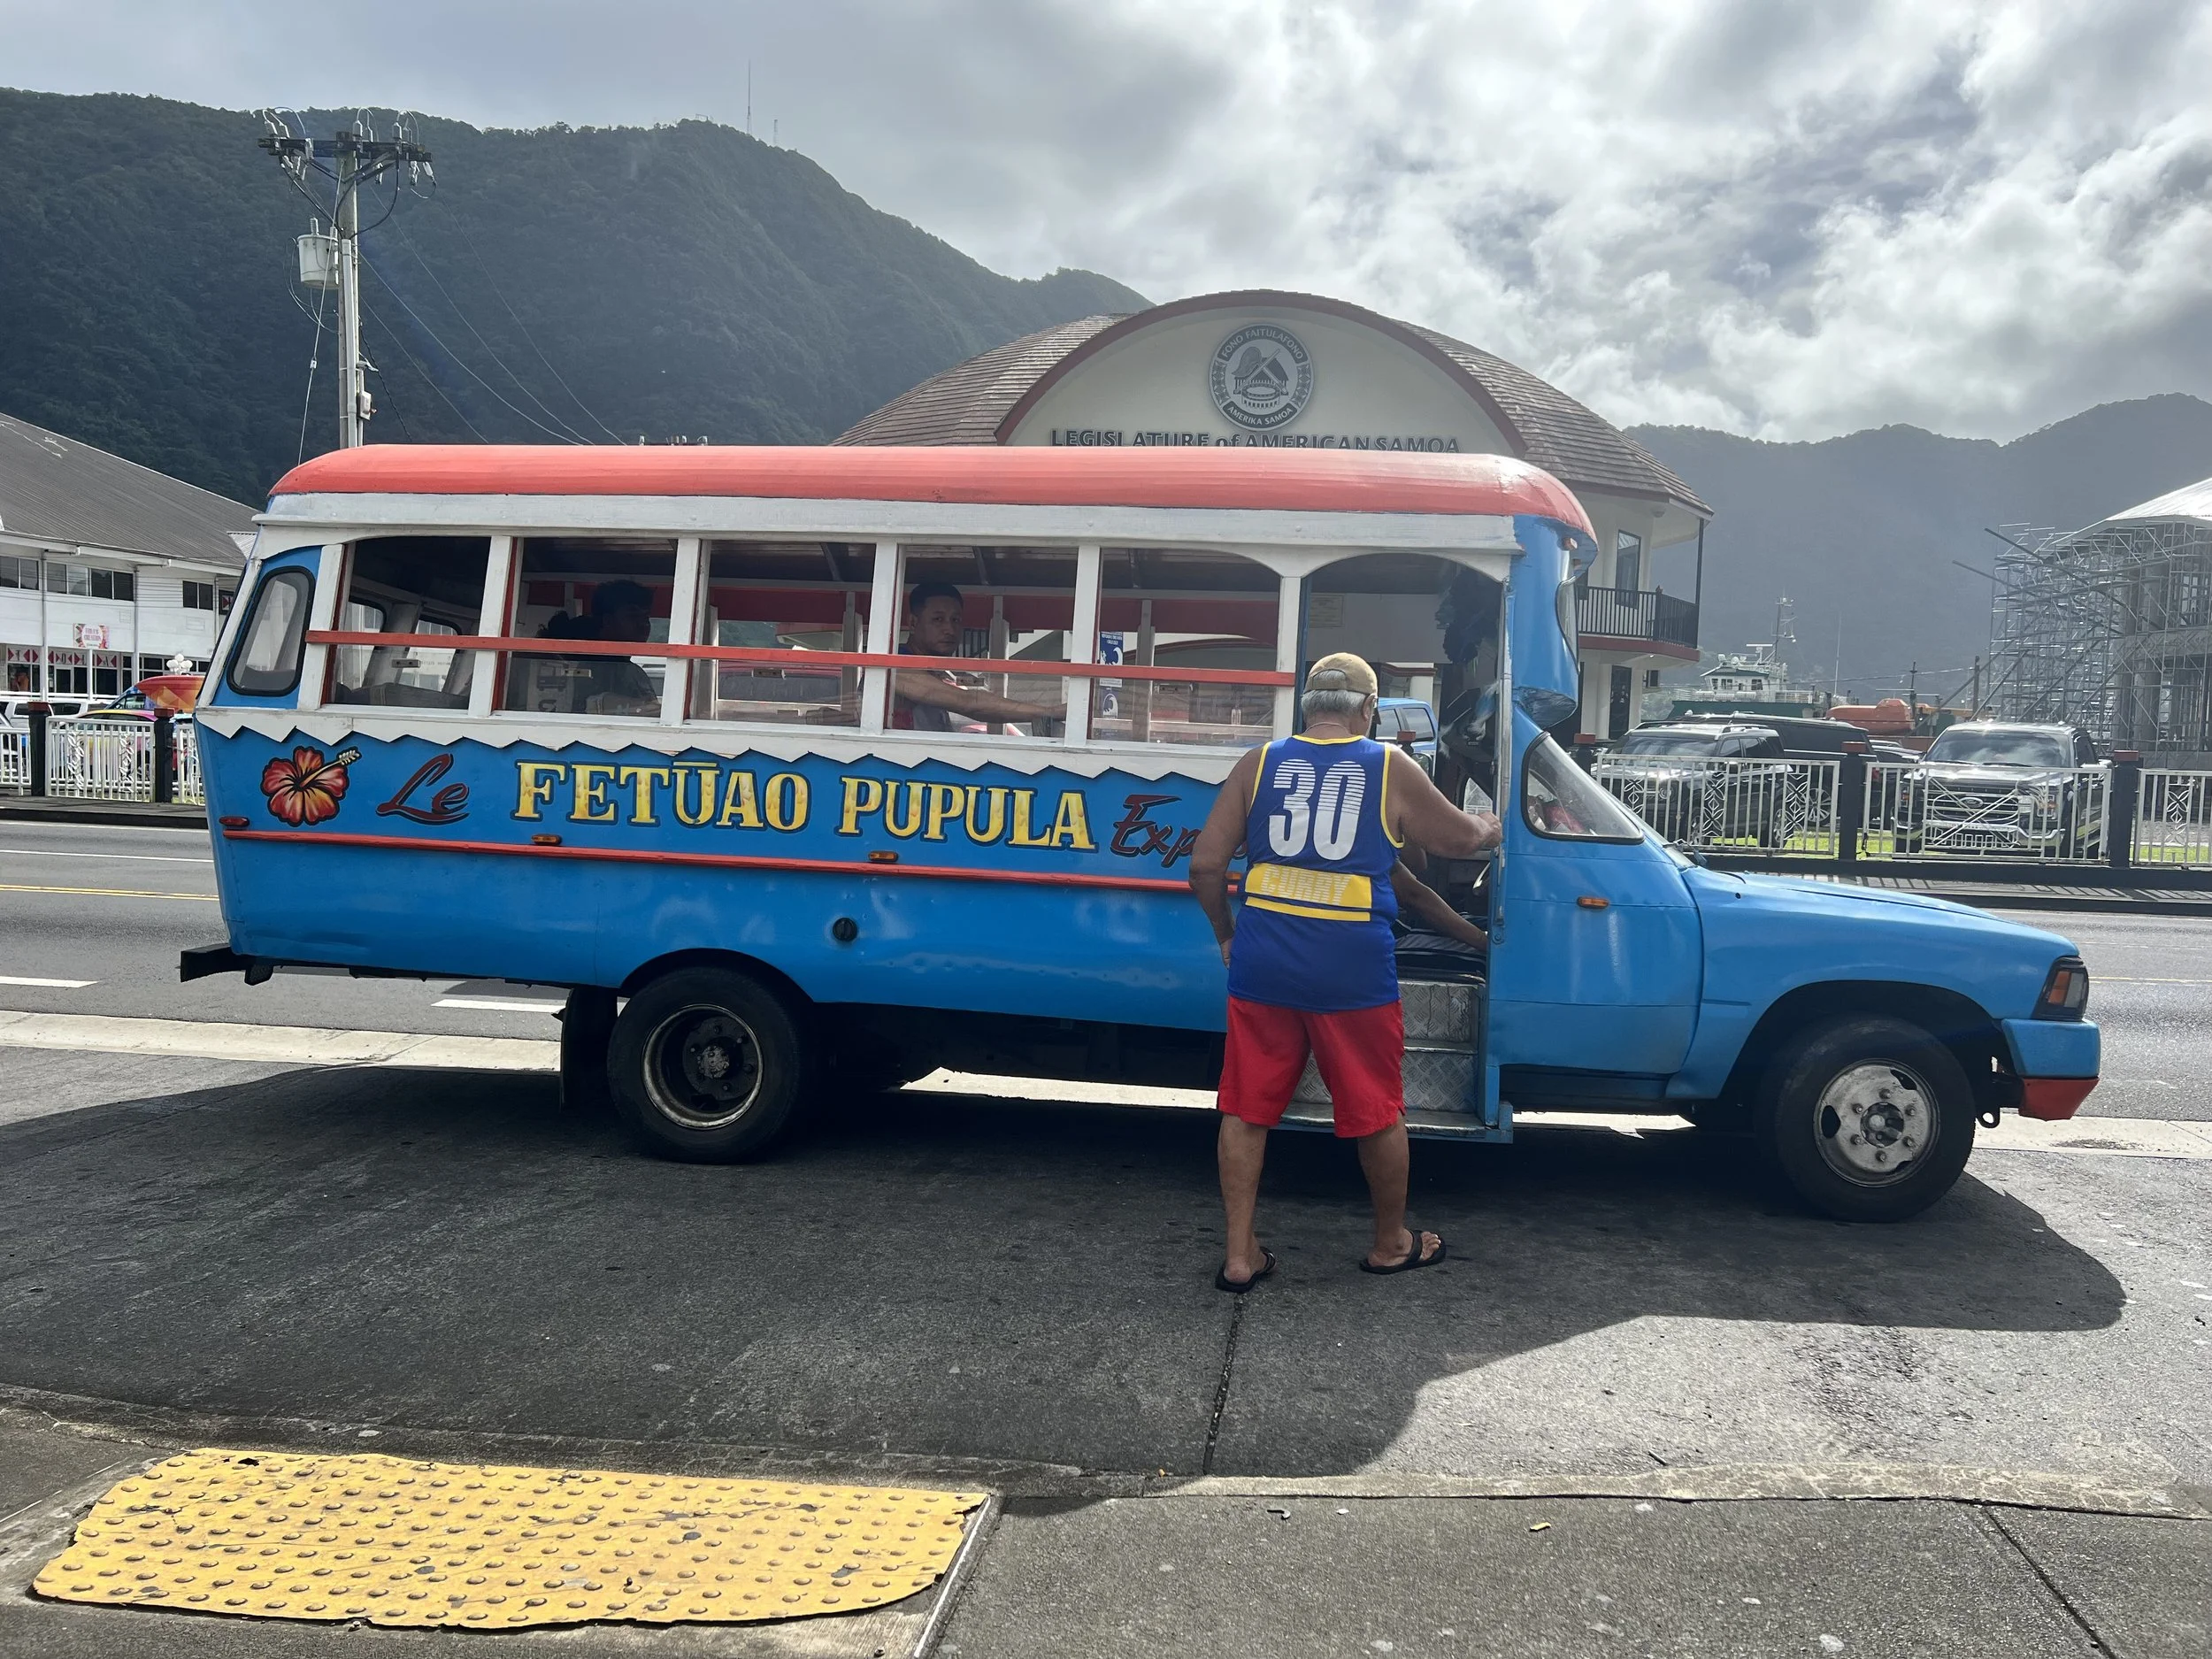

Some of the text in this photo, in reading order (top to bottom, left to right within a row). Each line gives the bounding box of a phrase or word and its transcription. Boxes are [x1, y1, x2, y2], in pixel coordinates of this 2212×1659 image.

[1222, 328, 1304, 359] FONO FAITULAFONO
[1227, 405, 1294, 425] AMERIKA SAMOA
[1216, 434, 1240, 447] of
[1245, 434, 1370, 449] AMERICAN
[1374, 436, 1460, 453] SAMOA
[375, 753, 1248, 868] Le FETŪAO PUPULA Exp
[1268, 758, 1366, 861] 30
[1261, 864, 1353, 906] CURRY
